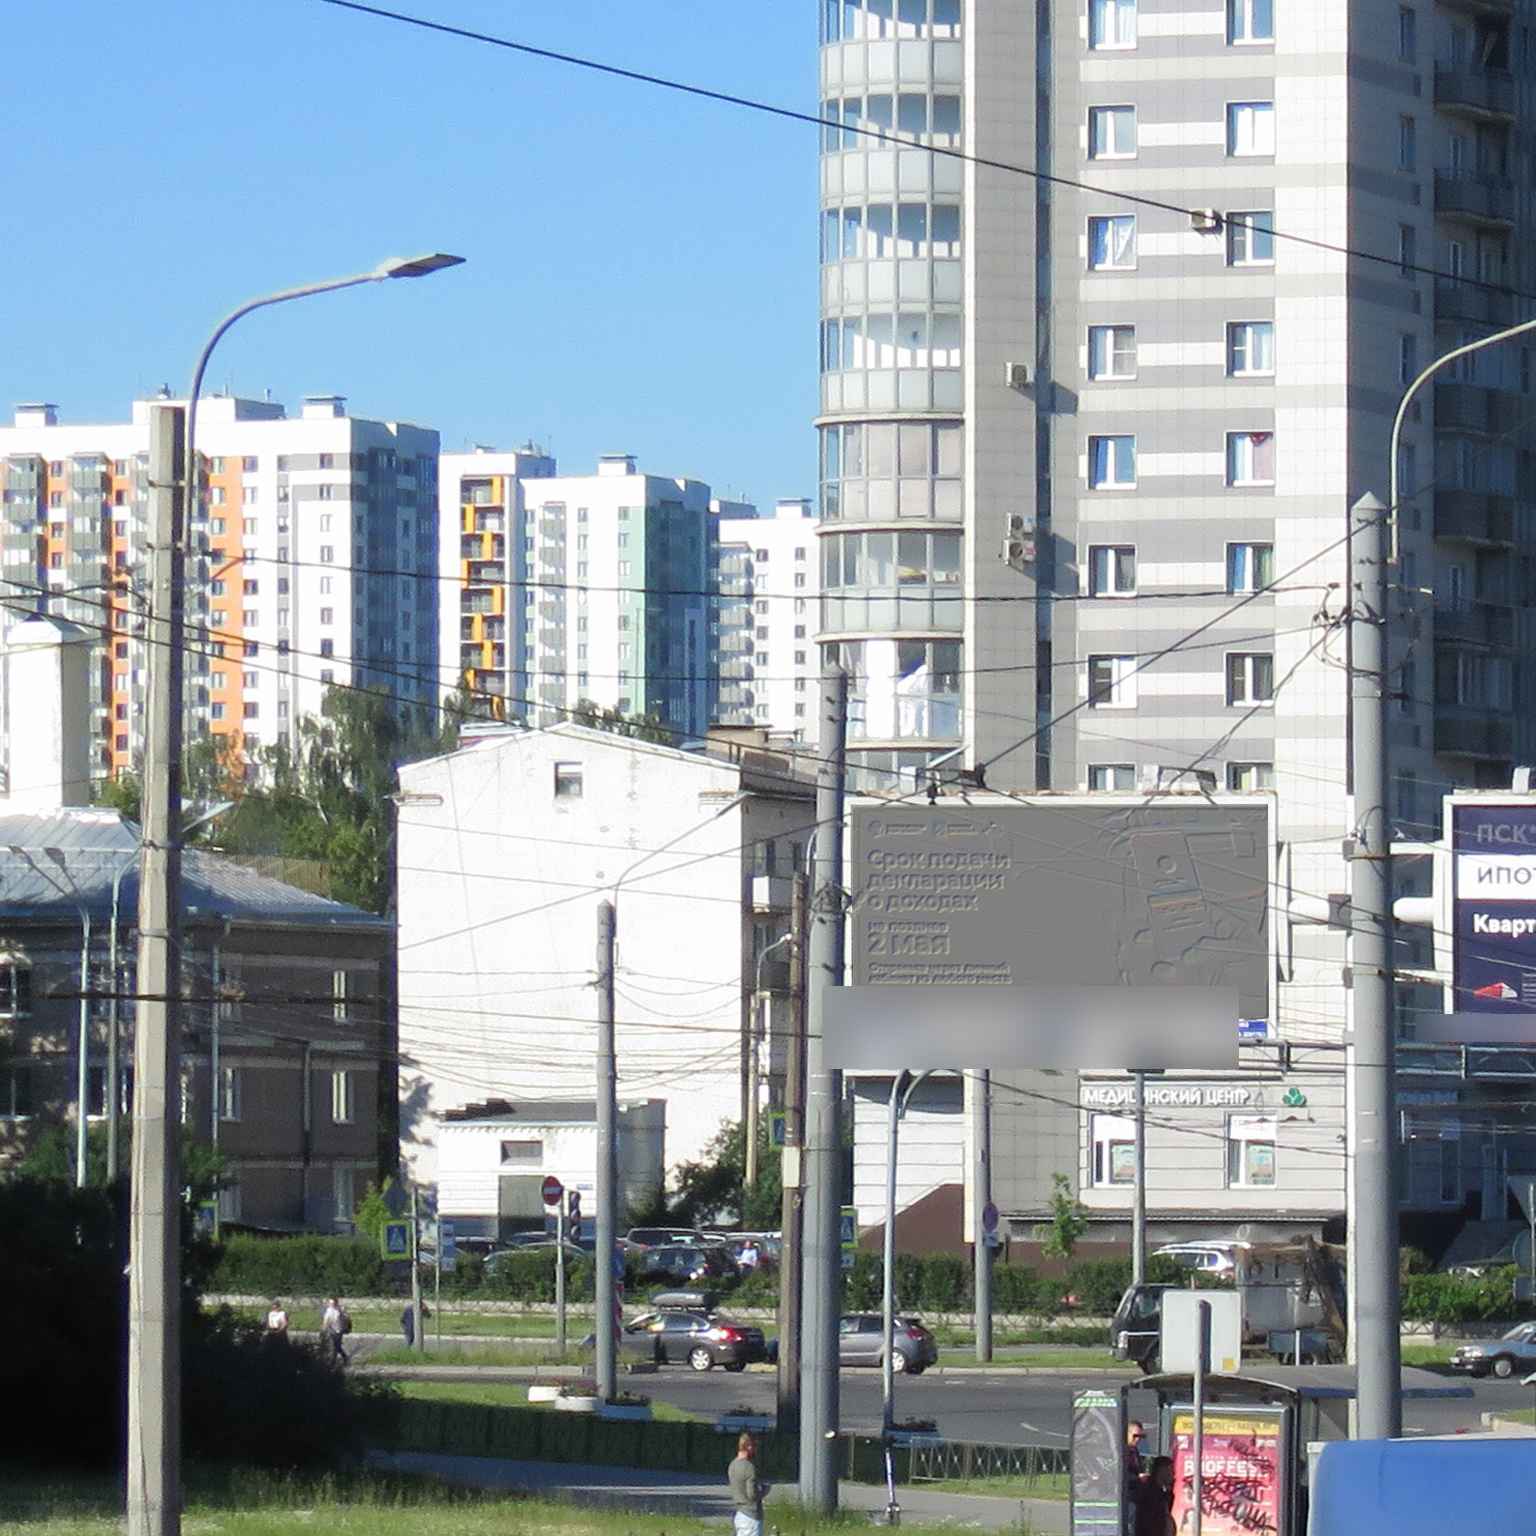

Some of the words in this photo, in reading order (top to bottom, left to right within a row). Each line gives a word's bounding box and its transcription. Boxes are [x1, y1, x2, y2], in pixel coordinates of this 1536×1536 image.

[867, 850, 924, 871] Срок
[928, 852, 1011, 870] подачи
[867, 873, 1005, 892] декларации
[867, 895, 882, 911] о
[886, 894, 979, 912] доходах
[868, 934, 887, 955] 2
[1206, 1089, 1249, 1105] ЦЕНТР
